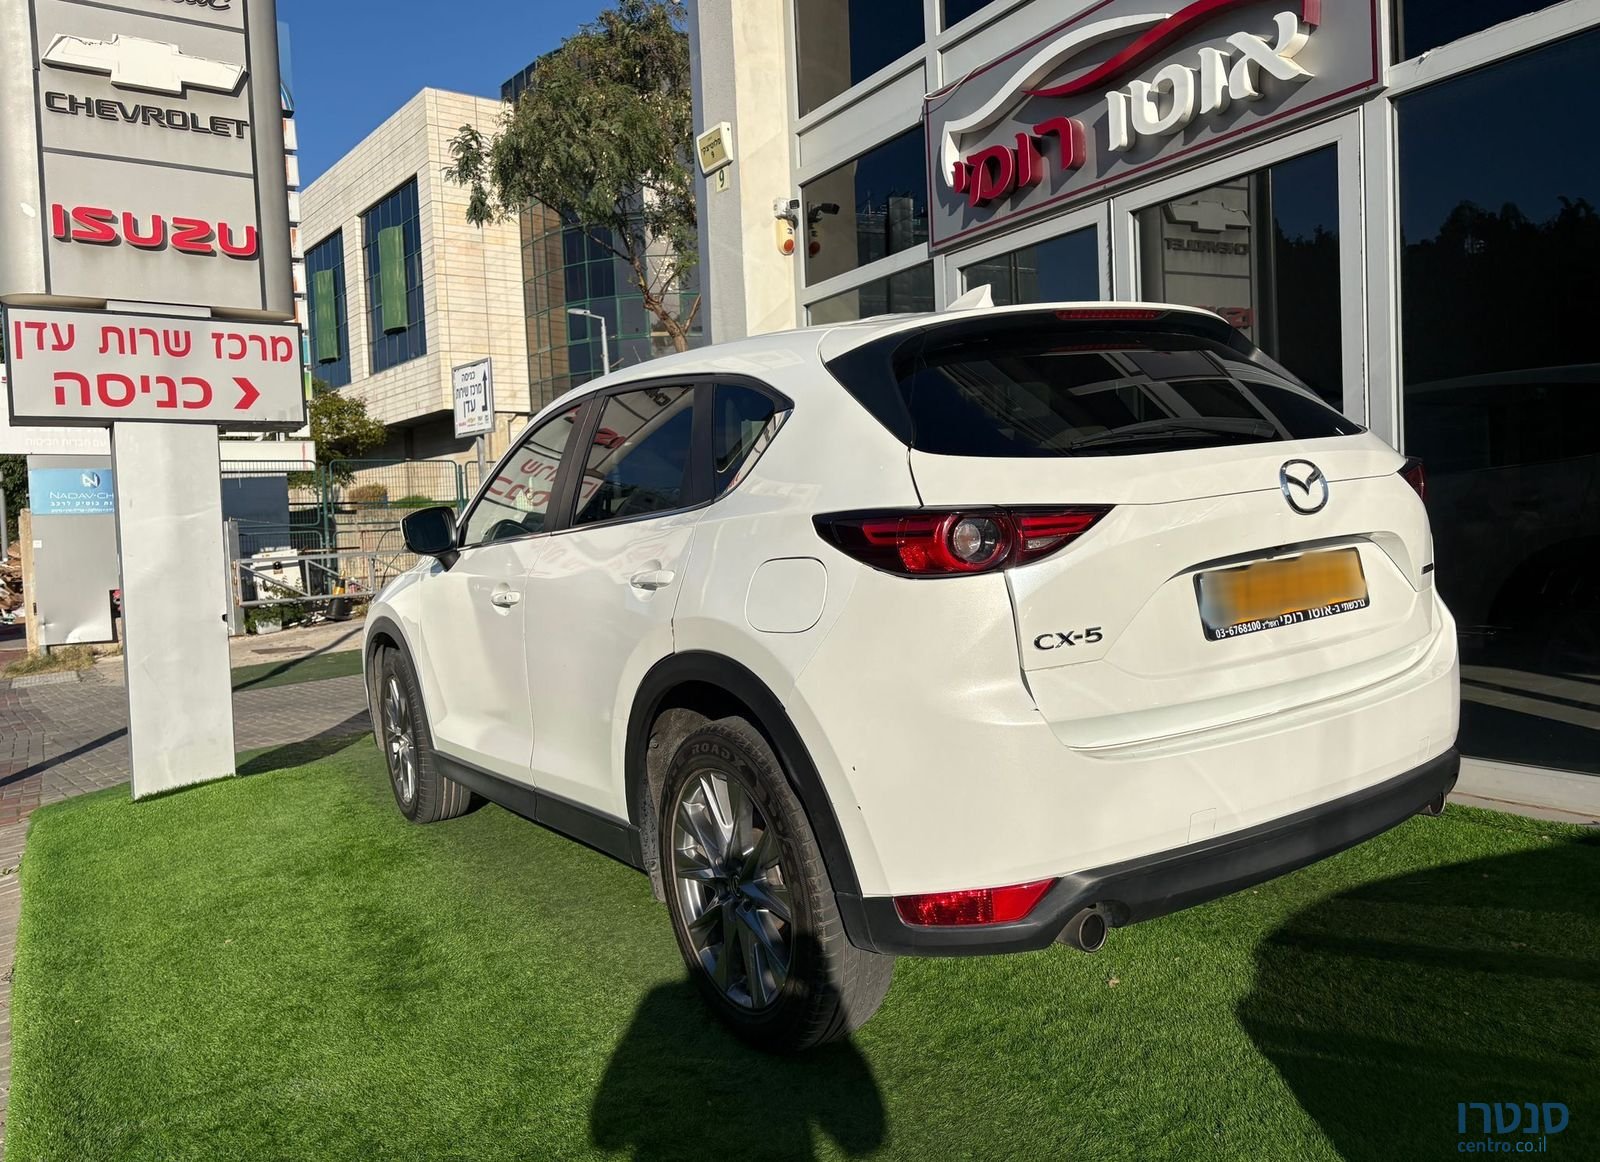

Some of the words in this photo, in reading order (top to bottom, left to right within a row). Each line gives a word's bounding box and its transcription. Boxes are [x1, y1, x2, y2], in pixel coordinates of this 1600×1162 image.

[1106, 11, 1315, 152] אוטו
[45, 91, 250, 139] CHEVROLET
[953, 116, 1086, 208] רומי
[719, 169, 725, 188] 9
[51, 204, 260, 257] ISUZU
[14, 320, 76, 360] עדן
[99, 325, 191, 358] שרות
[211, 332, 294, 363] מרכז
[461, 371, 476, 382] כניסה
[469, 383, 482, 396] מרכז
[53, 371, 213, 410] כניסה
[463, 399, 476, 418] עדן
[1279, 611, 1304, 625] רומי
[1343, 599, 1366, 612] נרכשתי
[1033, 626, 1103, 650] CX-5
[1215, 620, 1261, 639] 03-6768100
